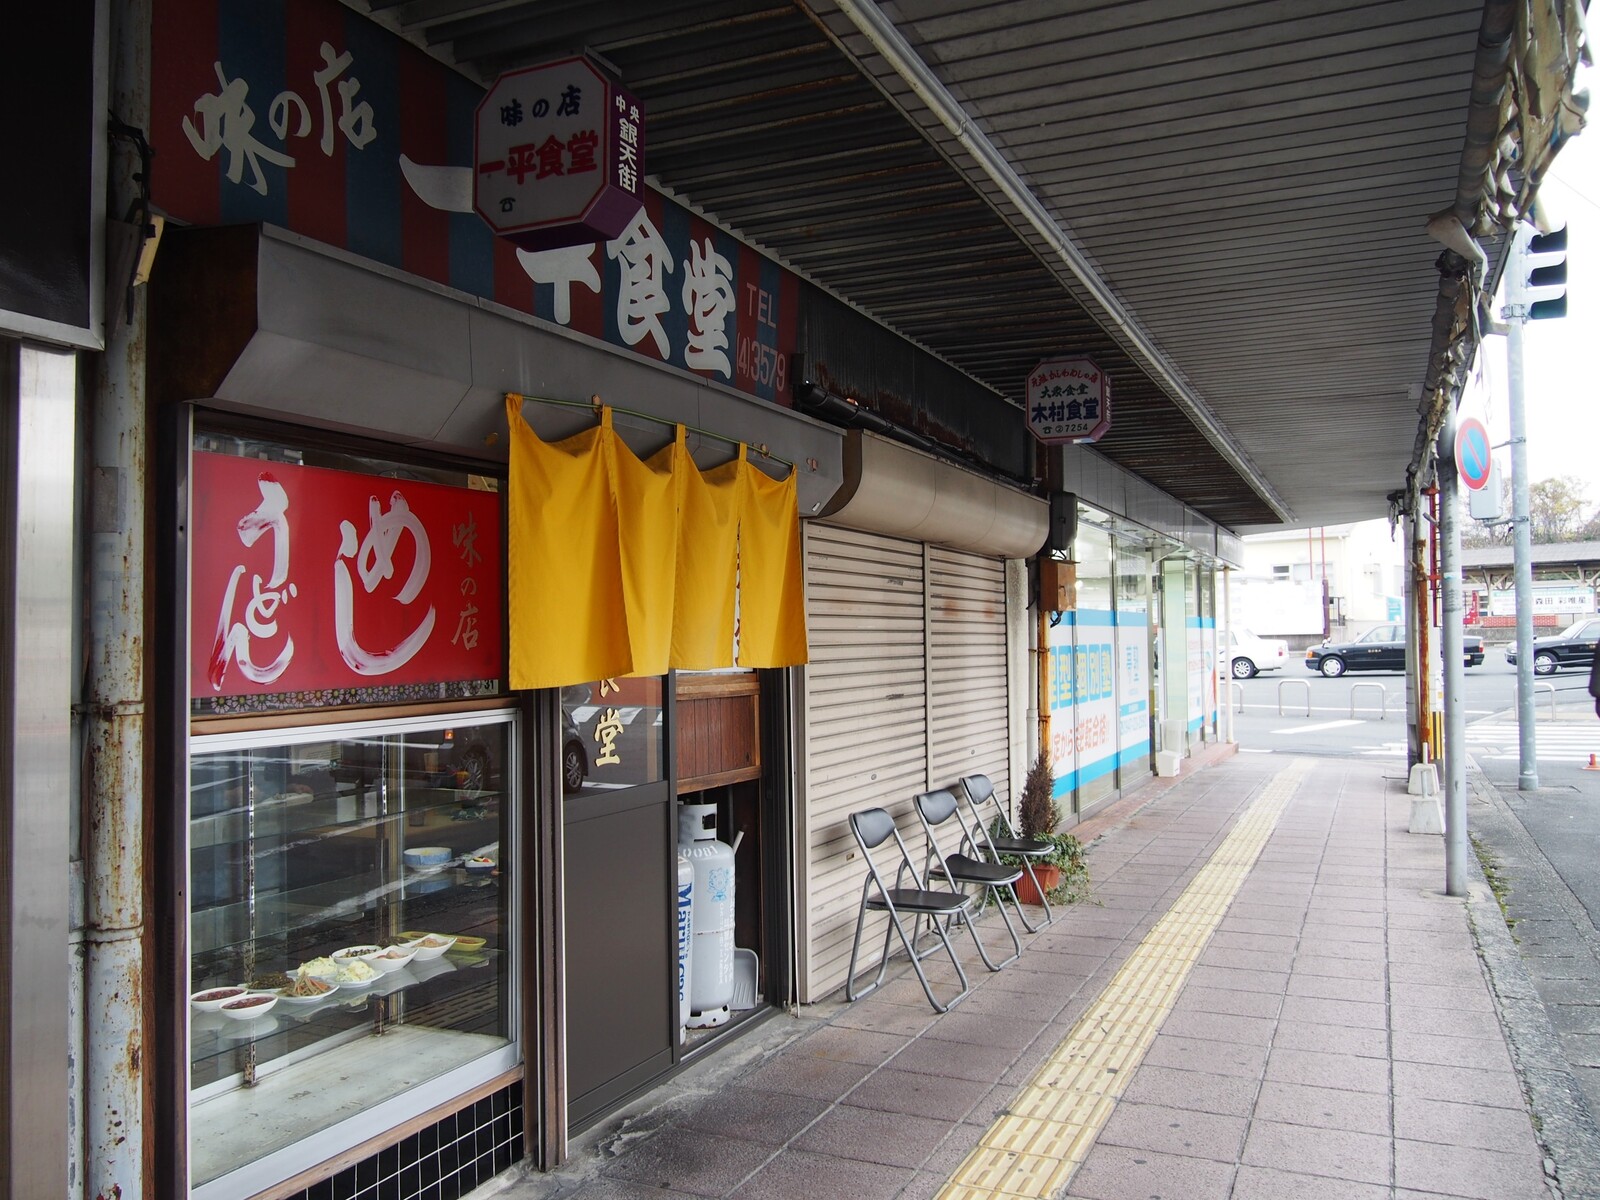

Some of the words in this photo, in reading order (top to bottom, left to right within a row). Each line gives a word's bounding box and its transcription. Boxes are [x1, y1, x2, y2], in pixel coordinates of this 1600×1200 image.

[182, 41, 377, 196] 味の店
[500, 84, 581, 126] 味の店
[616, 95, 640, 124] 中央
[479, 130, 598, 185] 一平食堂
[618, 117, 638, 194] 銀天街
[746, 283, 777, 329] TEL
[736, 332, 786, 392] (4)3579
[1031, 397, 1099, 423] 木村食堂
[1040, 383, 1088, 399] 大衆食堂
[208, 472, 298, 692] うどん
[334, 490, 436, 676] めし
[451, 511, 482, 650] 味の店
